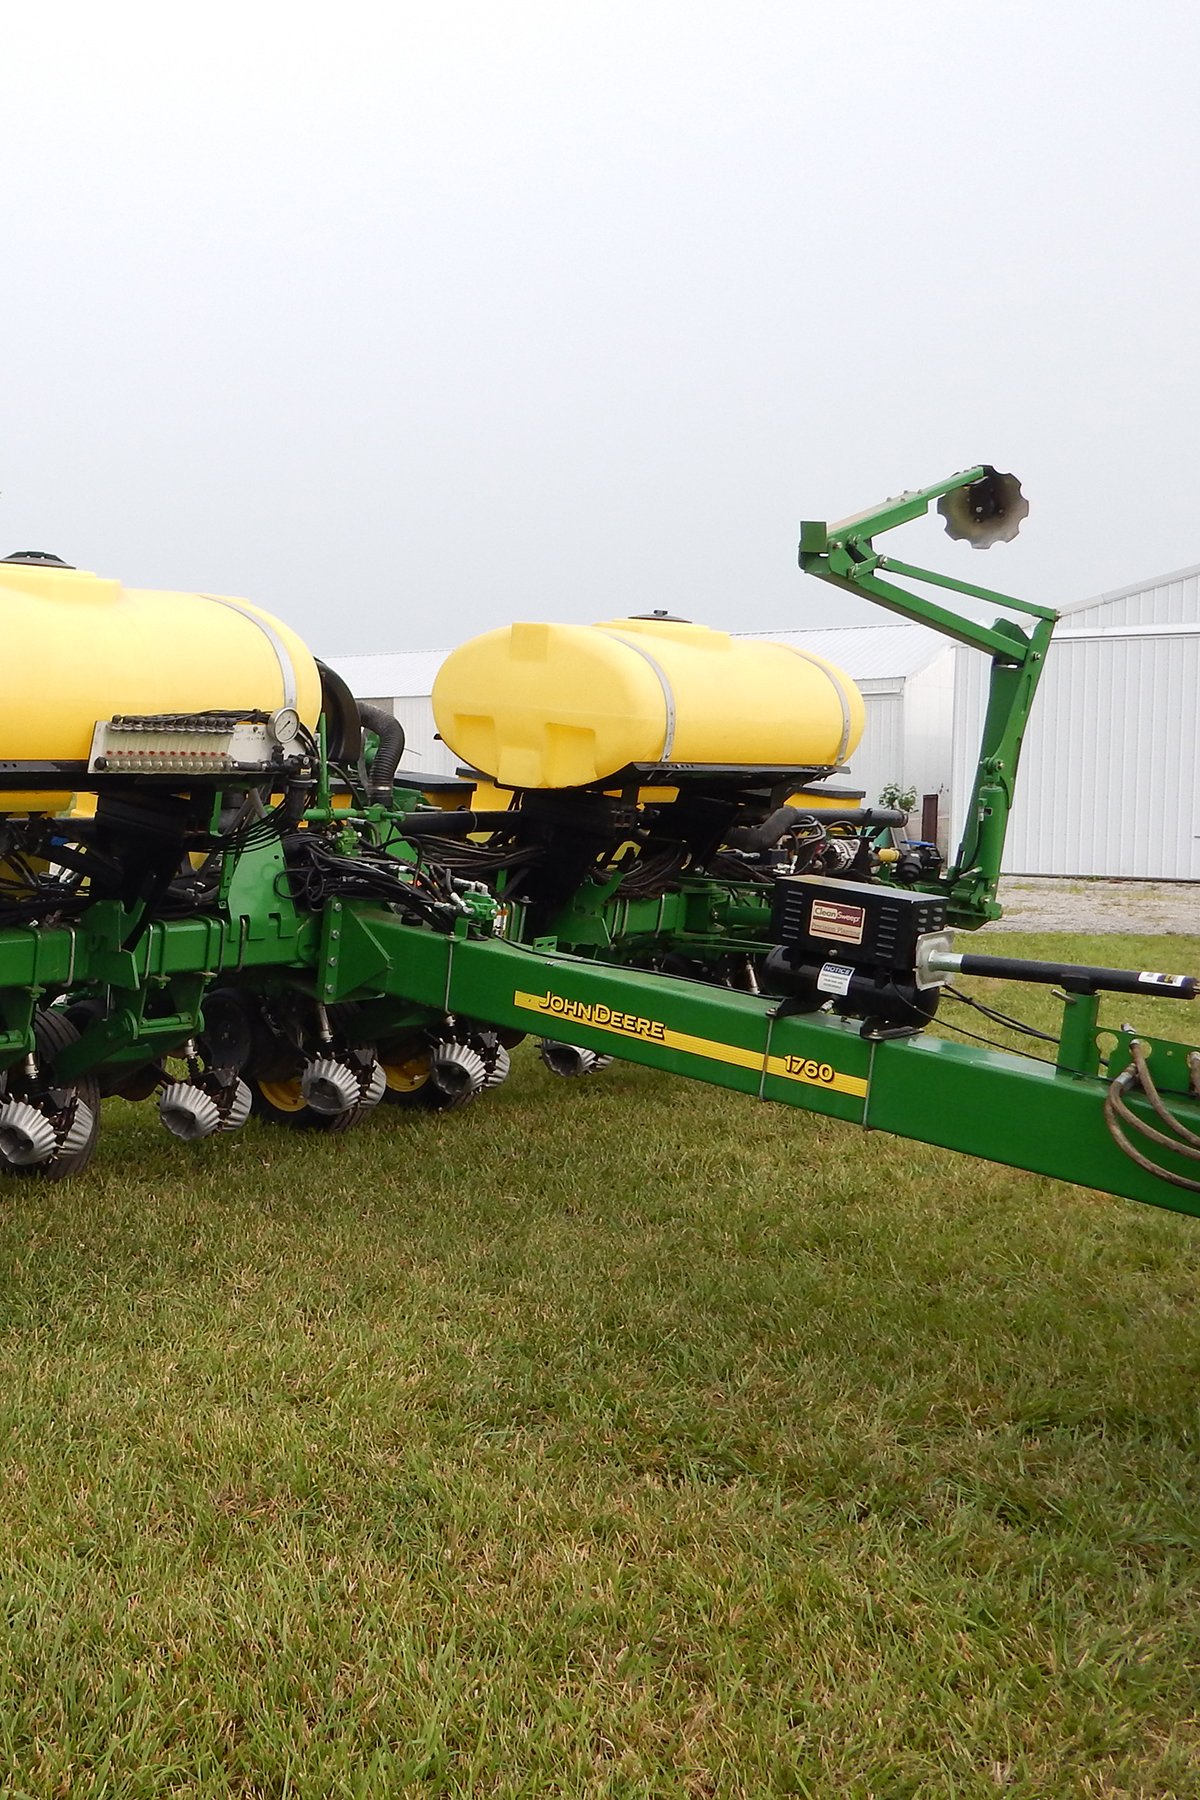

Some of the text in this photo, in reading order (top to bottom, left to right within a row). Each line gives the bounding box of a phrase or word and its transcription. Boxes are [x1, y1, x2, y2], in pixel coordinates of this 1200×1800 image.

[815, 907, 836, 918] Clean
[825, 965, 851, 975] NOTICE
[539, 990, 665, 1040] JOHN DEERE
[784, 1054, 835, 1083] 1760
